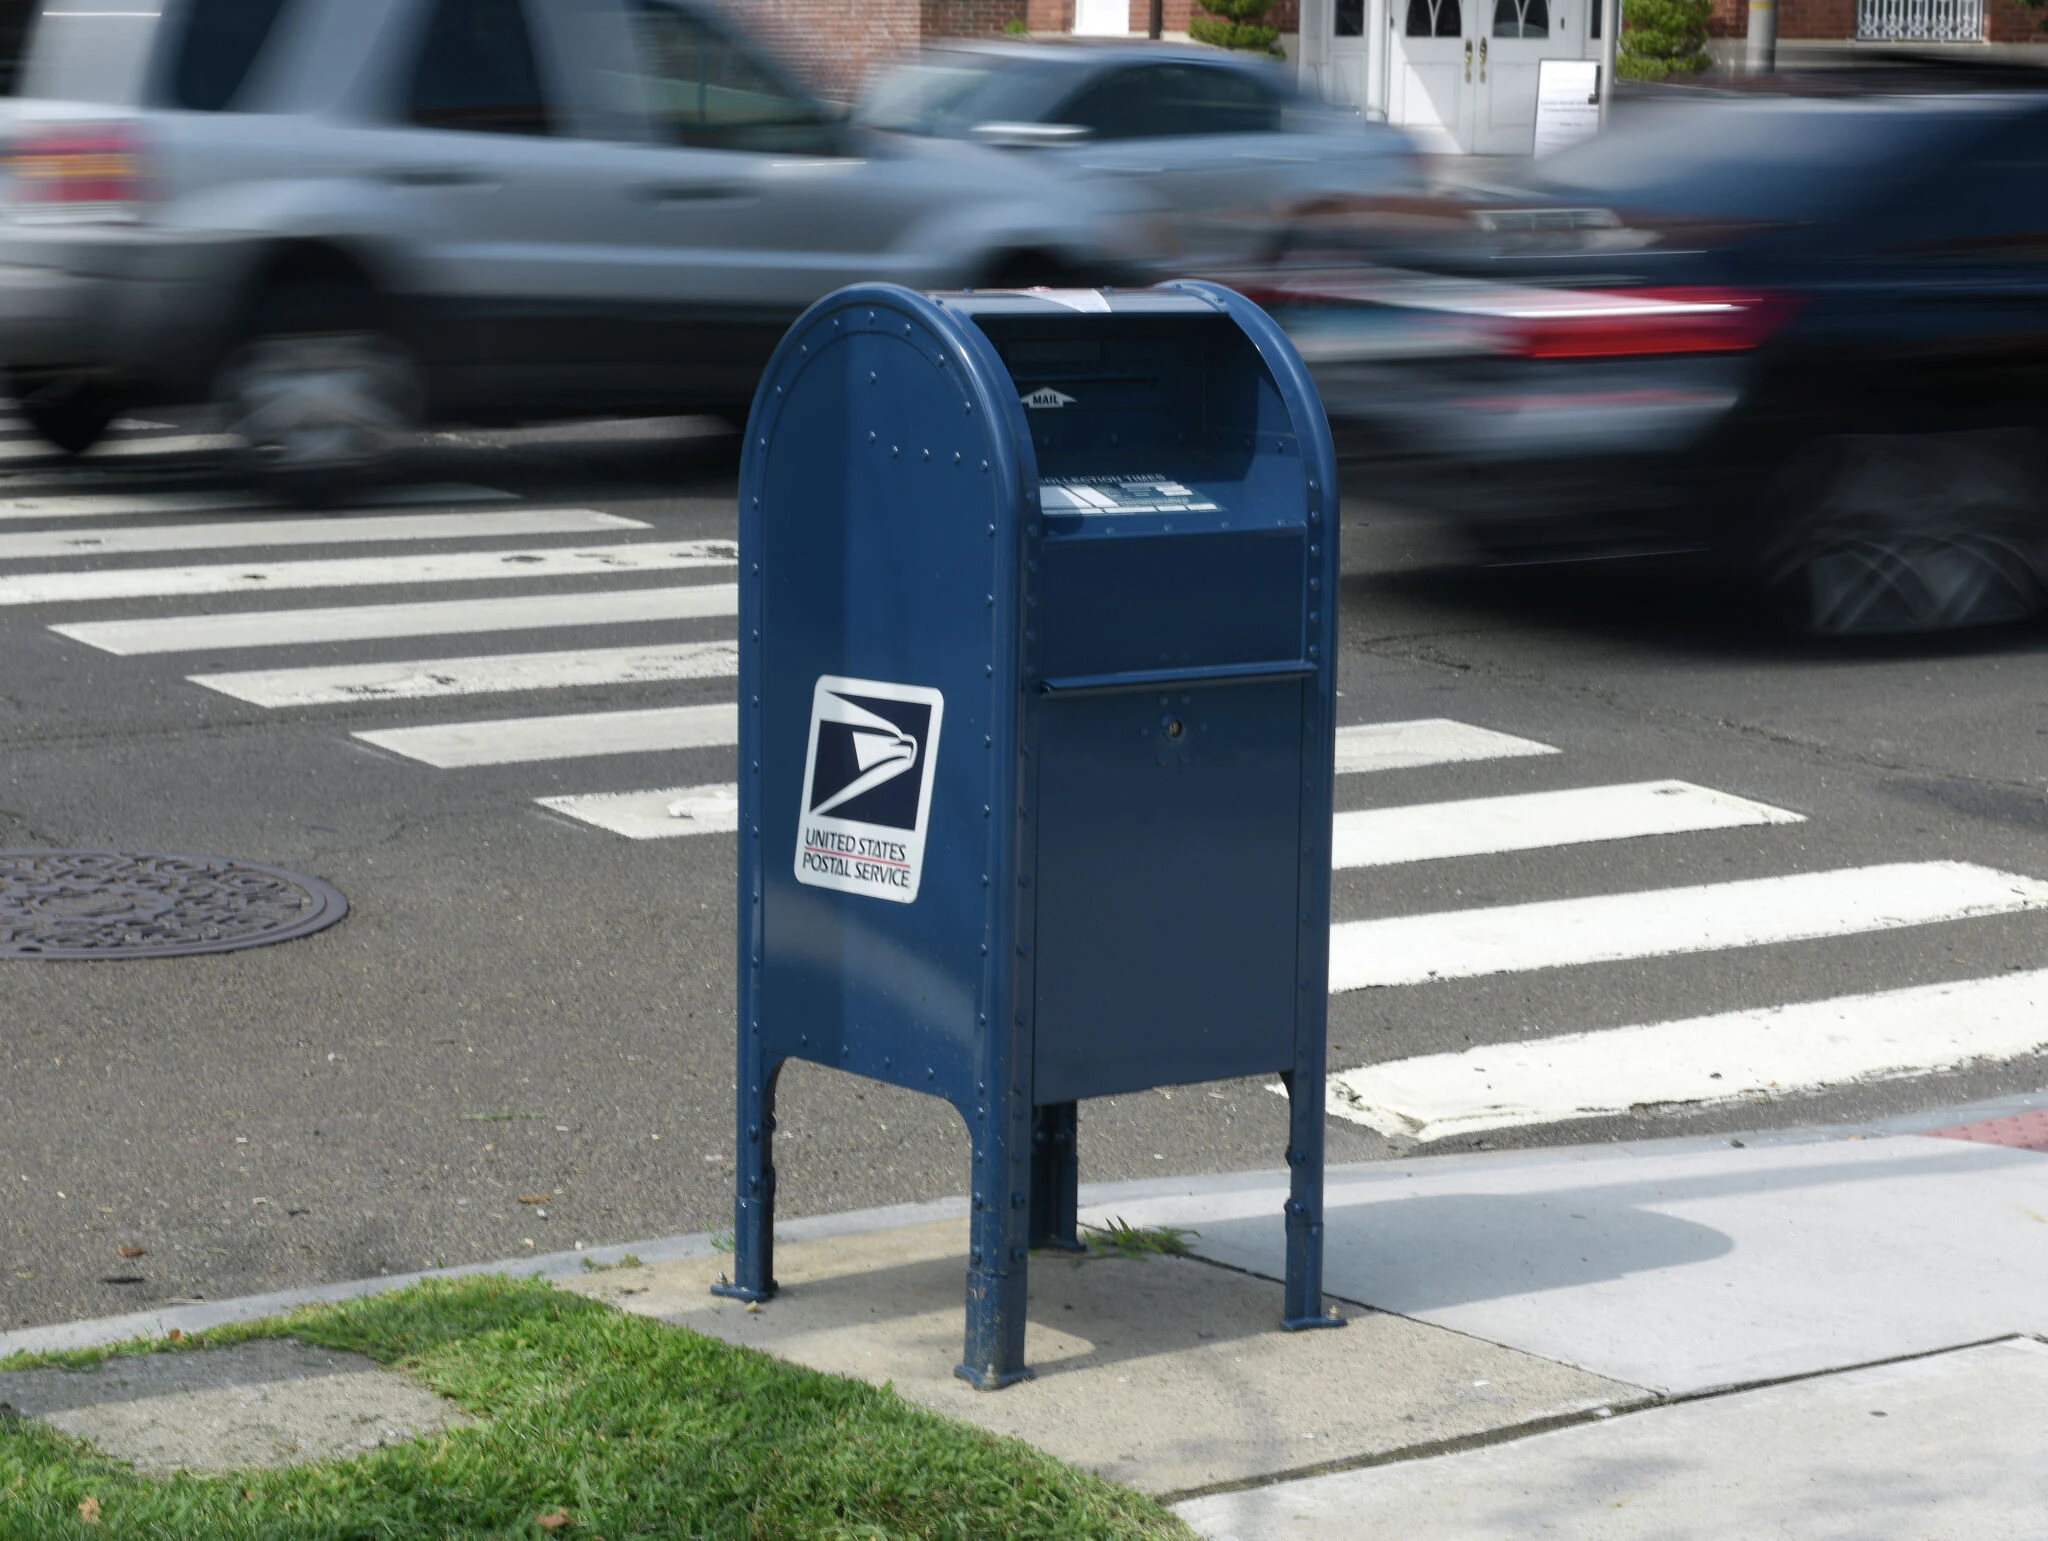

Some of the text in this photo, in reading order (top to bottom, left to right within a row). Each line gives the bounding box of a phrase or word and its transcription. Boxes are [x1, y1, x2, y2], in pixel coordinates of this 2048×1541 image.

[1032, 393, 1058, 405] MAIL
[805, 827, 906, 861] UNITED STATES
[802, 851, 911, 888] POSTAL SERVICE
